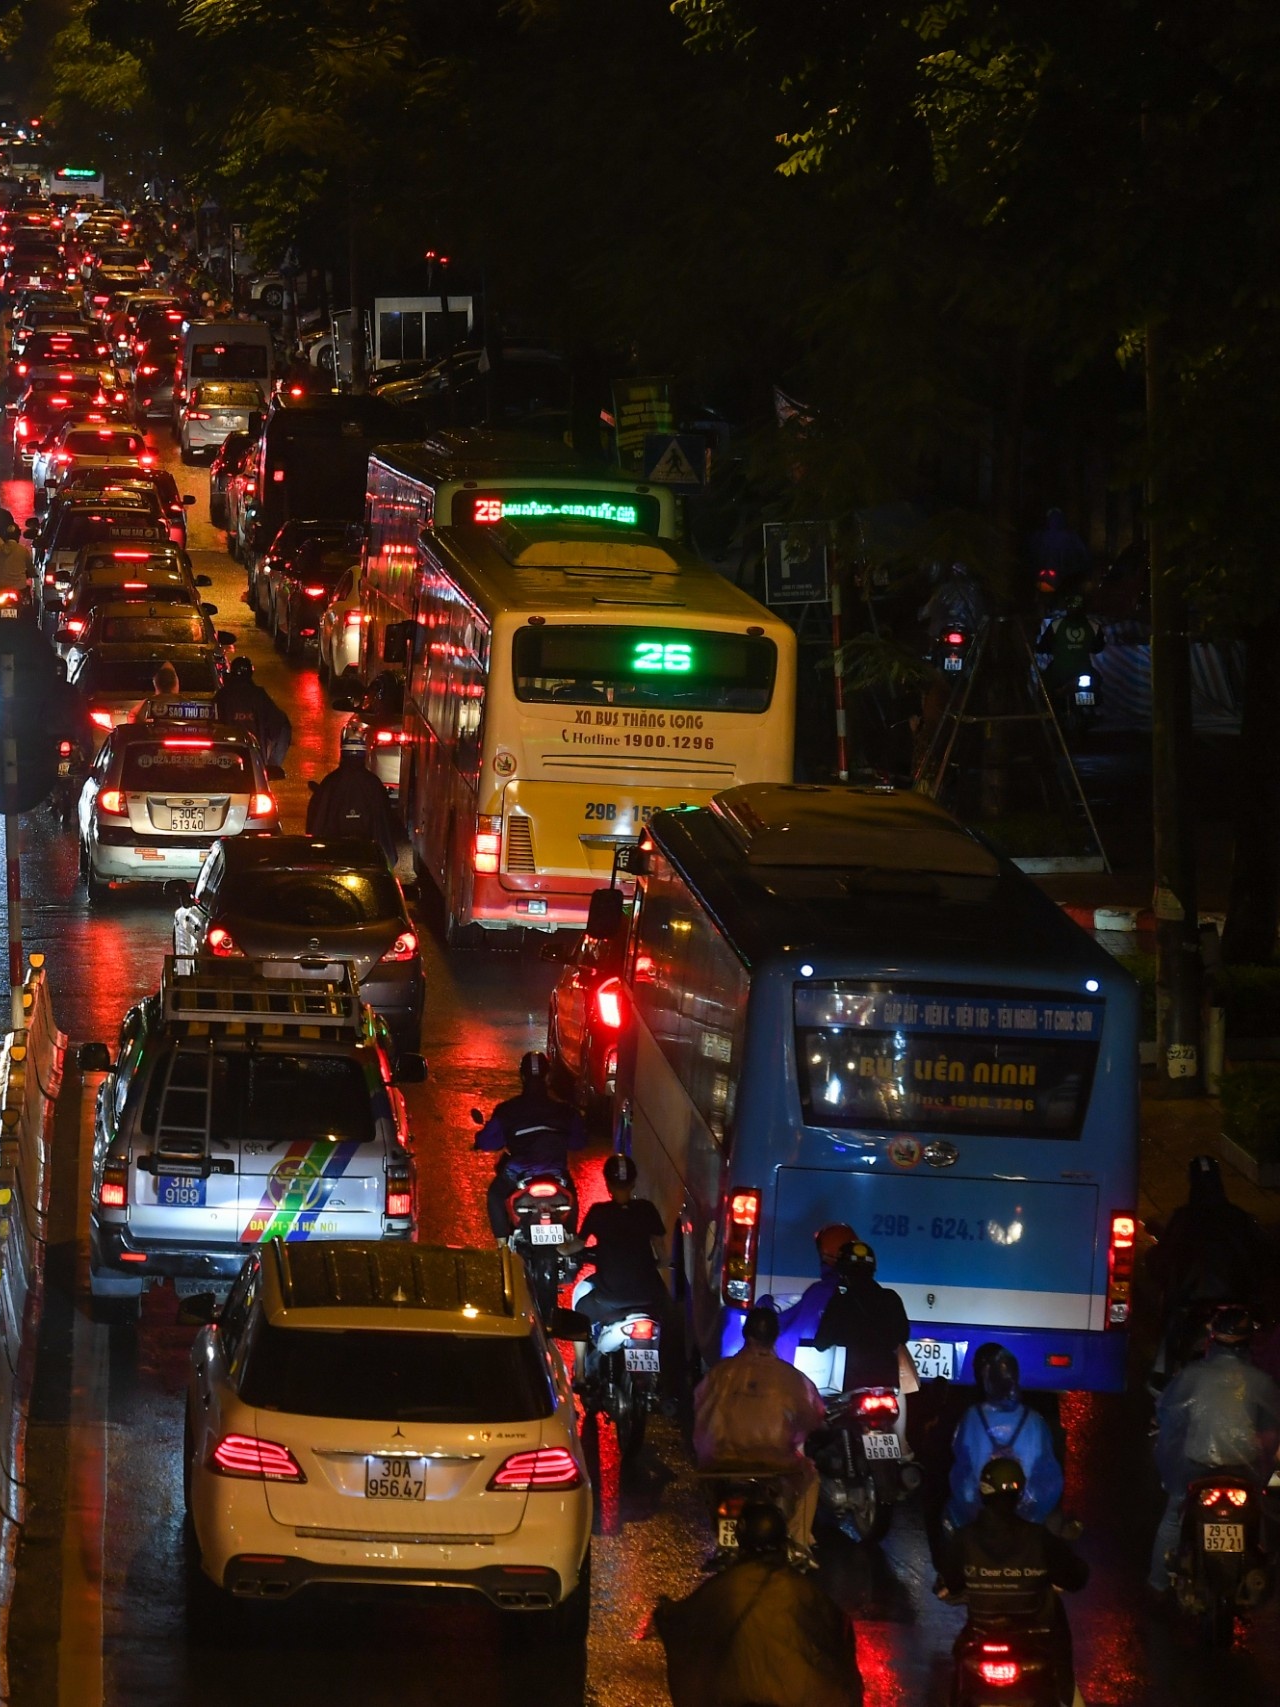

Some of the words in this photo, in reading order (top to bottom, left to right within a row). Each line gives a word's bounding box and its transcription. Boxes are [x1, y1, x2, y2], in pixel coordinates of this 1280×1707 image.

[475, 499, 501, 521] 26
[633, 643, 692, 671] 26
[169, 706, 183, 716] SAO
[575, 710, 592, 725] XN
[595, 711, 619, 726] BUS
[623, 709, 666, 728] THĂNG
[670, 713, 703, 729] LONG
[573, 732, 620, 746] Hotline
[624, 734, 714, 750] 1900.1296
[585, 802, 616, 821] 29B
[172, 820, 204, 830] 513.40
[914, 1054, 965, 1082] LIÊN
[973, 1062, 1036, 1086] NINH
[165, 1188, 199, 1204] 9199
[872, 1214, 909, 1237] 29B
[382, 1460, 411, 1478] 30A
[370, 1479, 423, 1499] 956.47
[1209, 1525, 1238, 1537] 29-C1
[1206, 1538, 1241, 1549] 357.21
[980, 1567, 1001, 1576] Dear
[1003, 1567, 1021, 1576] Cab
